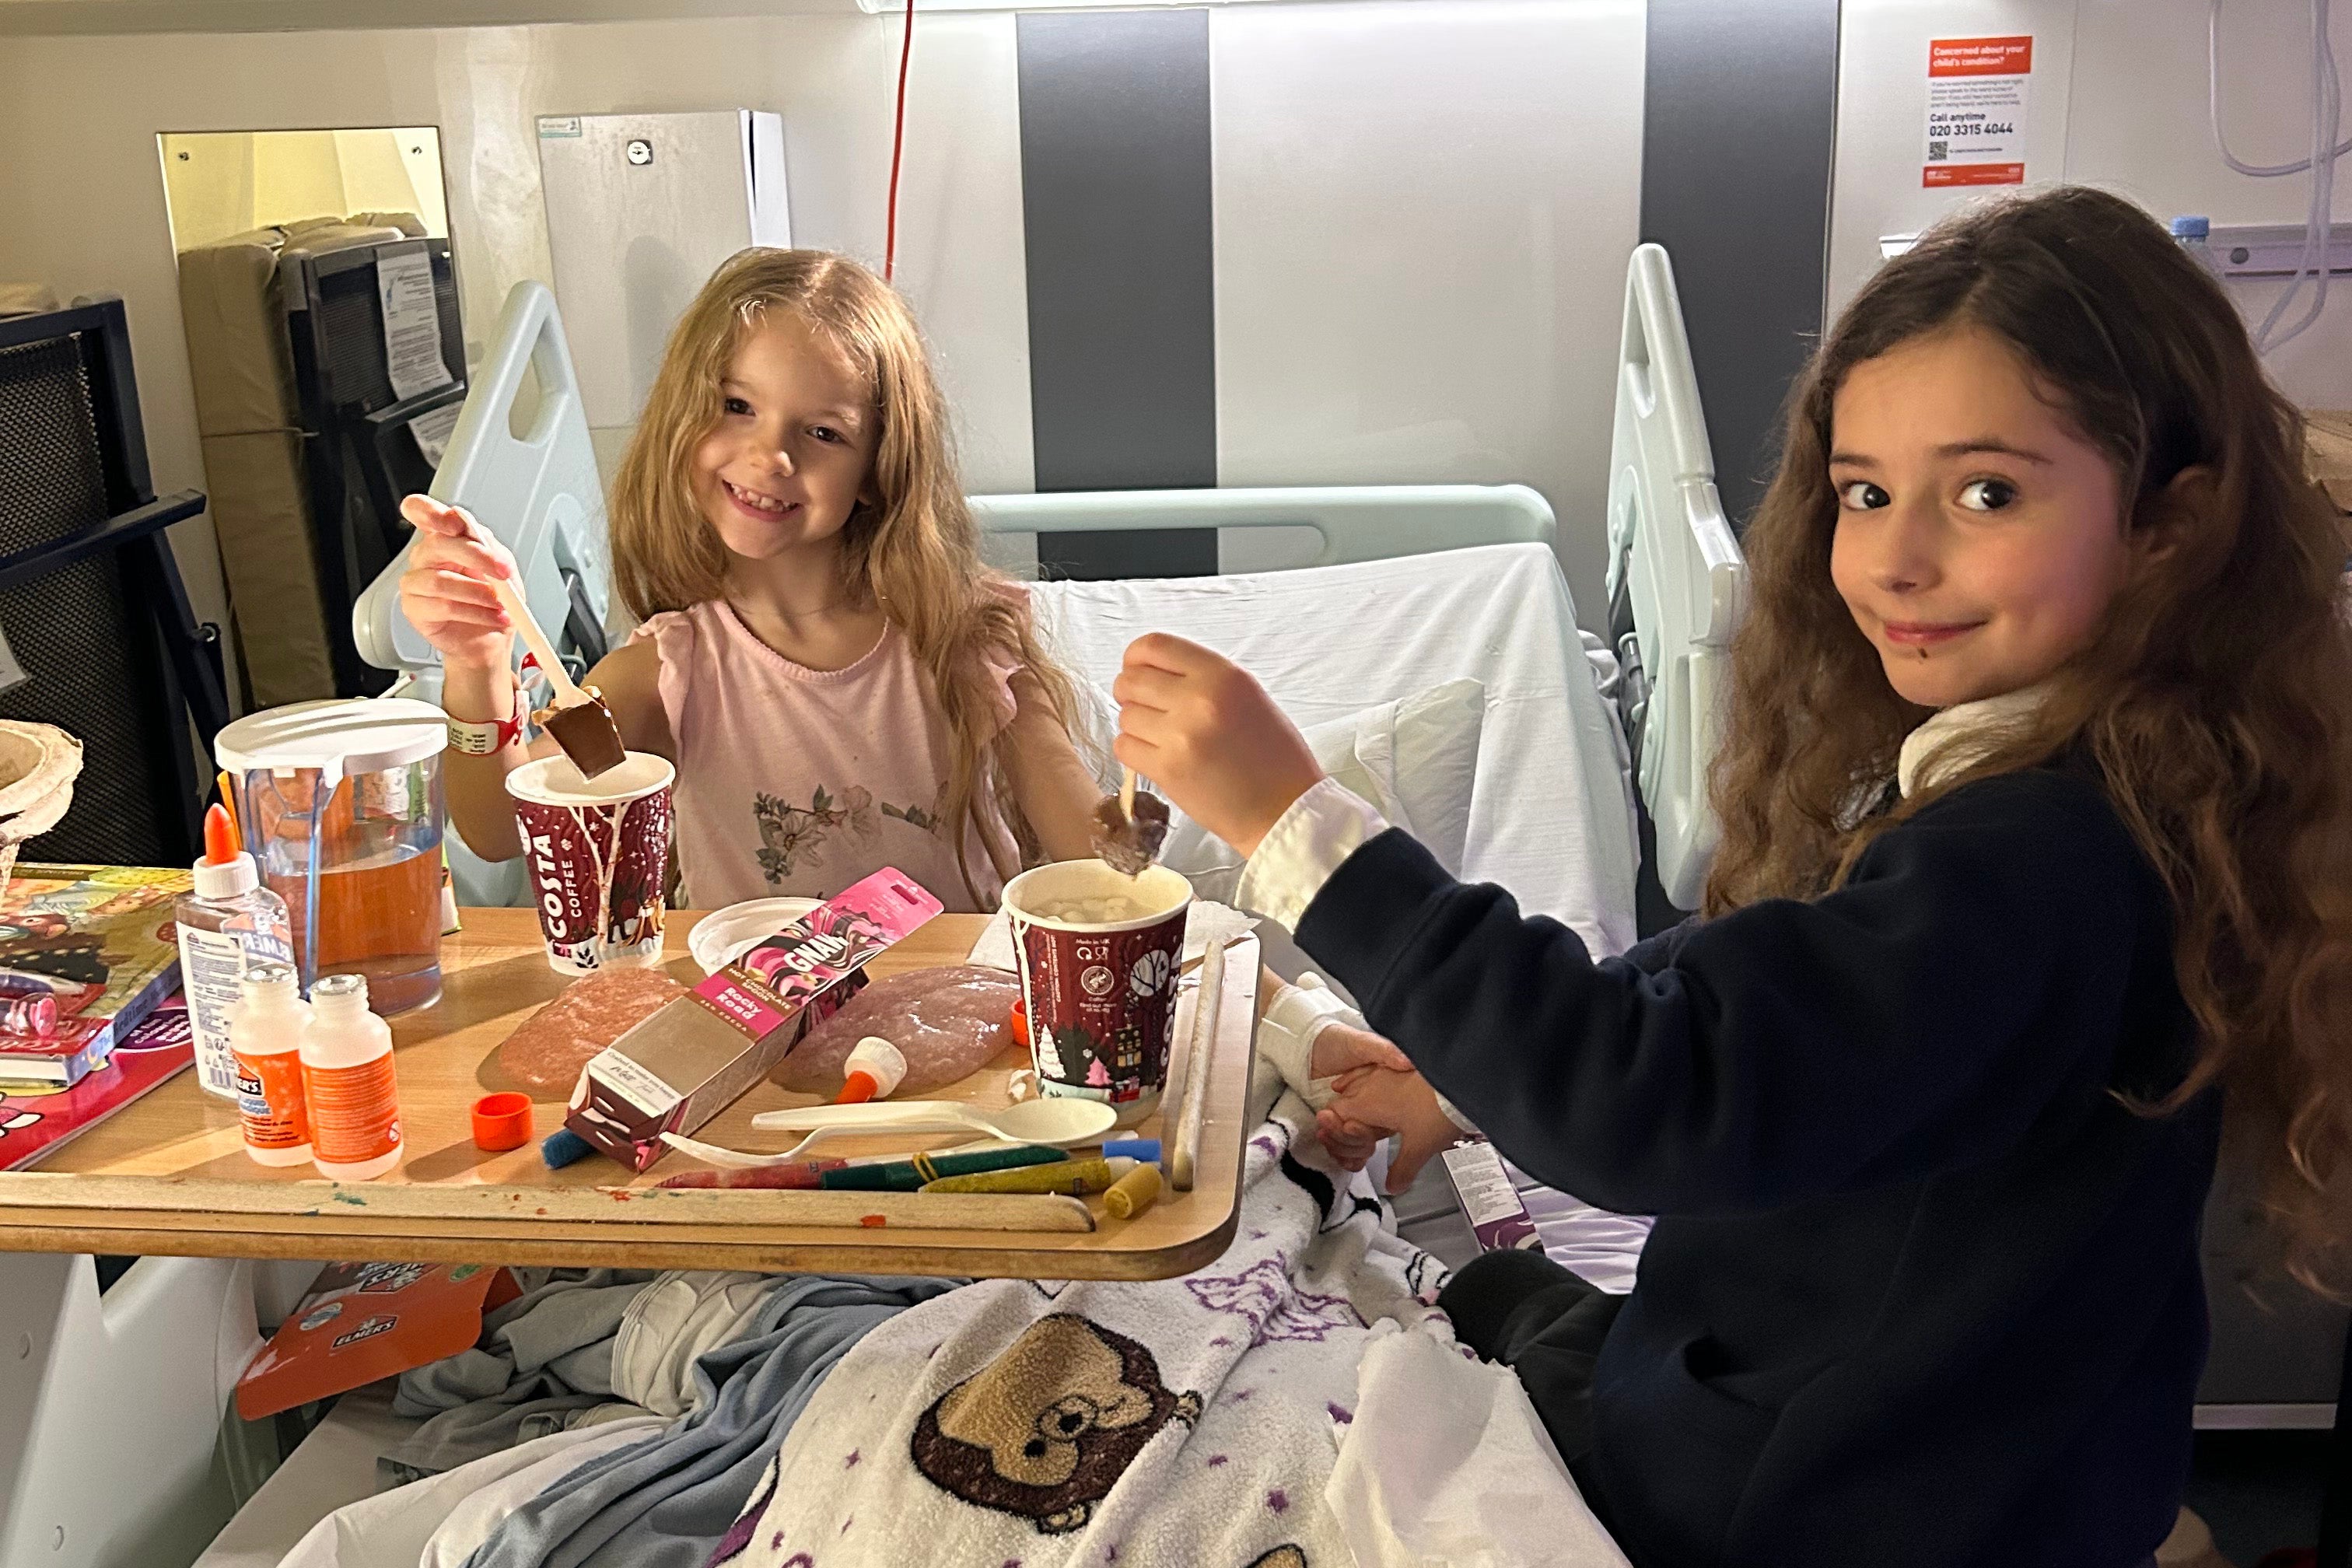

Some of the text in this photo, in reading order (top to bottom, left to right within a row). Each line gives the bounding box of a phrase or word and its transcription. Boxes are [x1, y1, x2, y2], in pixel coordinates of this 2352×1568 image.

[1980, 46, 2004, 54] about
[2005, 46, 2025, 55] your
[1930, 113, 1986, 123] Call anytime
[1930, 122, 2013, 136] 020 3315 4044
[533, 835, 567, 938] COSTA
[562, 859, 582, 918] COFFEE
[783, 932, 850, 972] GNAW
[723, 987, 763, 1013] Rocky
[728, 968, 792, 1010] HOT CHOCOLATE
[741, 982, 769, 1002] SPOON
[716, 992, 756, 1020] Road
[236, 1076, 260, 1093] ER'S
[336, 1318, 394, 1346] ELMER'S
